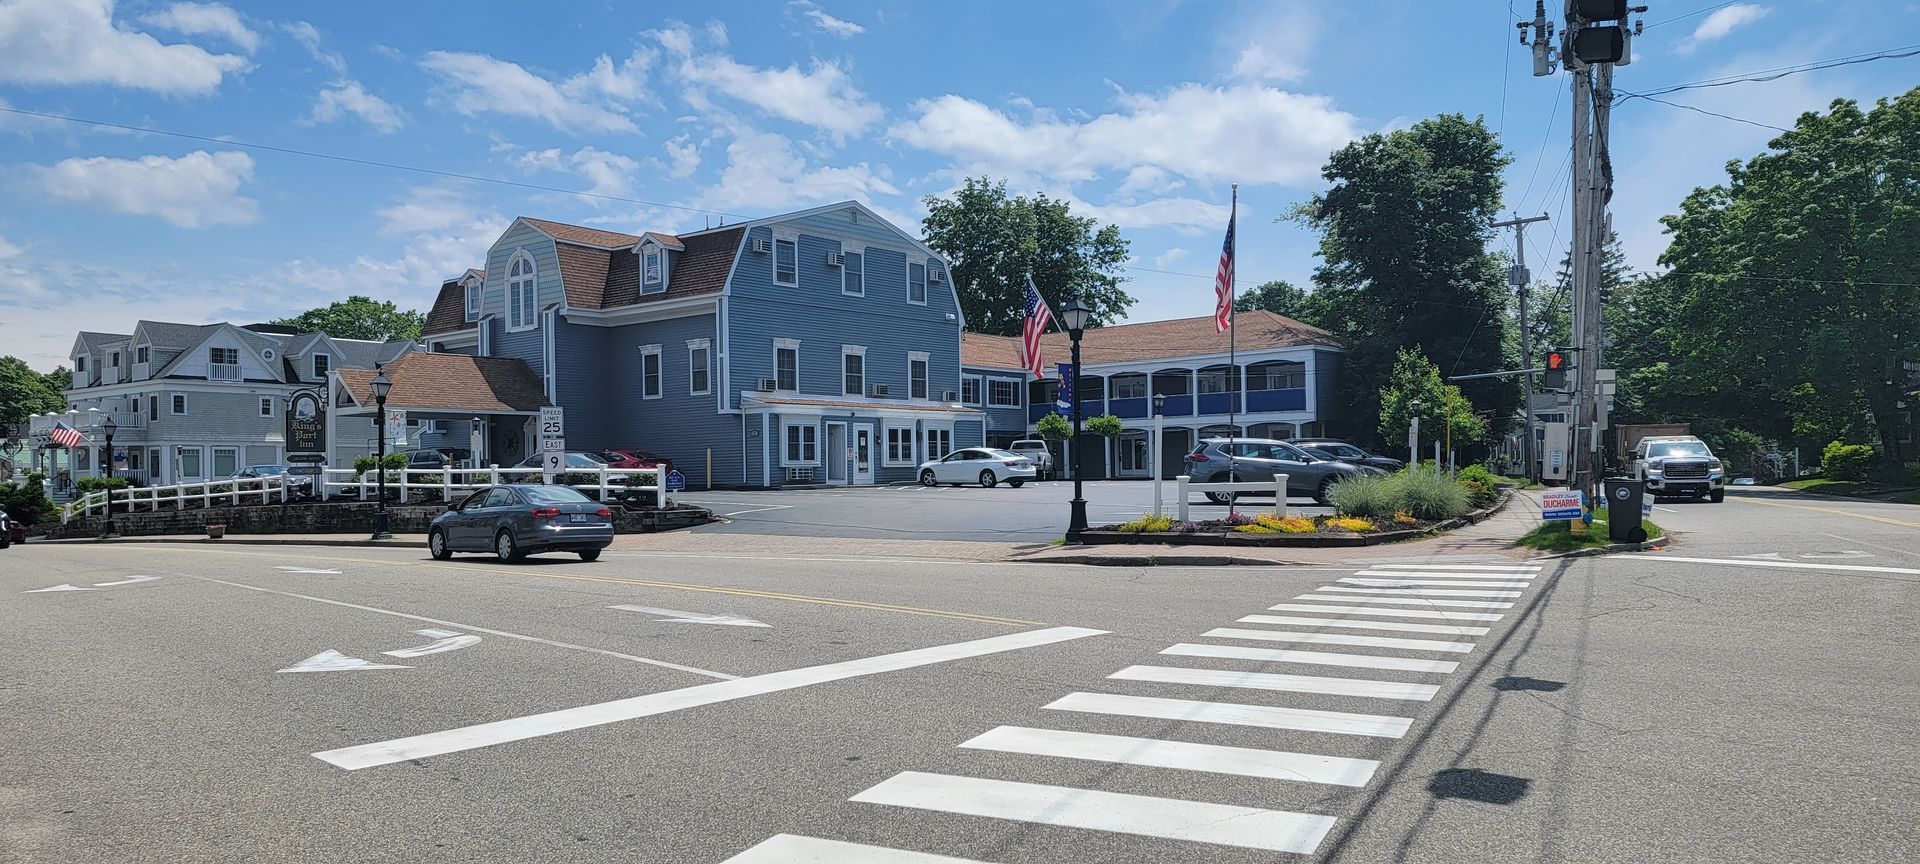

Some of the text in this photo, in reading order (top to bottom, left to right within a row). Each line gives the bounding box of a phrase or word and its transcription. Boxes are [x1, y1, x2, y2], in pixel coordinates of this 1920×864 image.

[291, 420, 322, 431] King's
[543, 422, 561, 433] 25
[294, 430, 317, 441] Port
[545, 440, 562, 449] EAST
[550, 456, 559, 469] 9
[1543, 498, 1580, 508] DUCHARME
